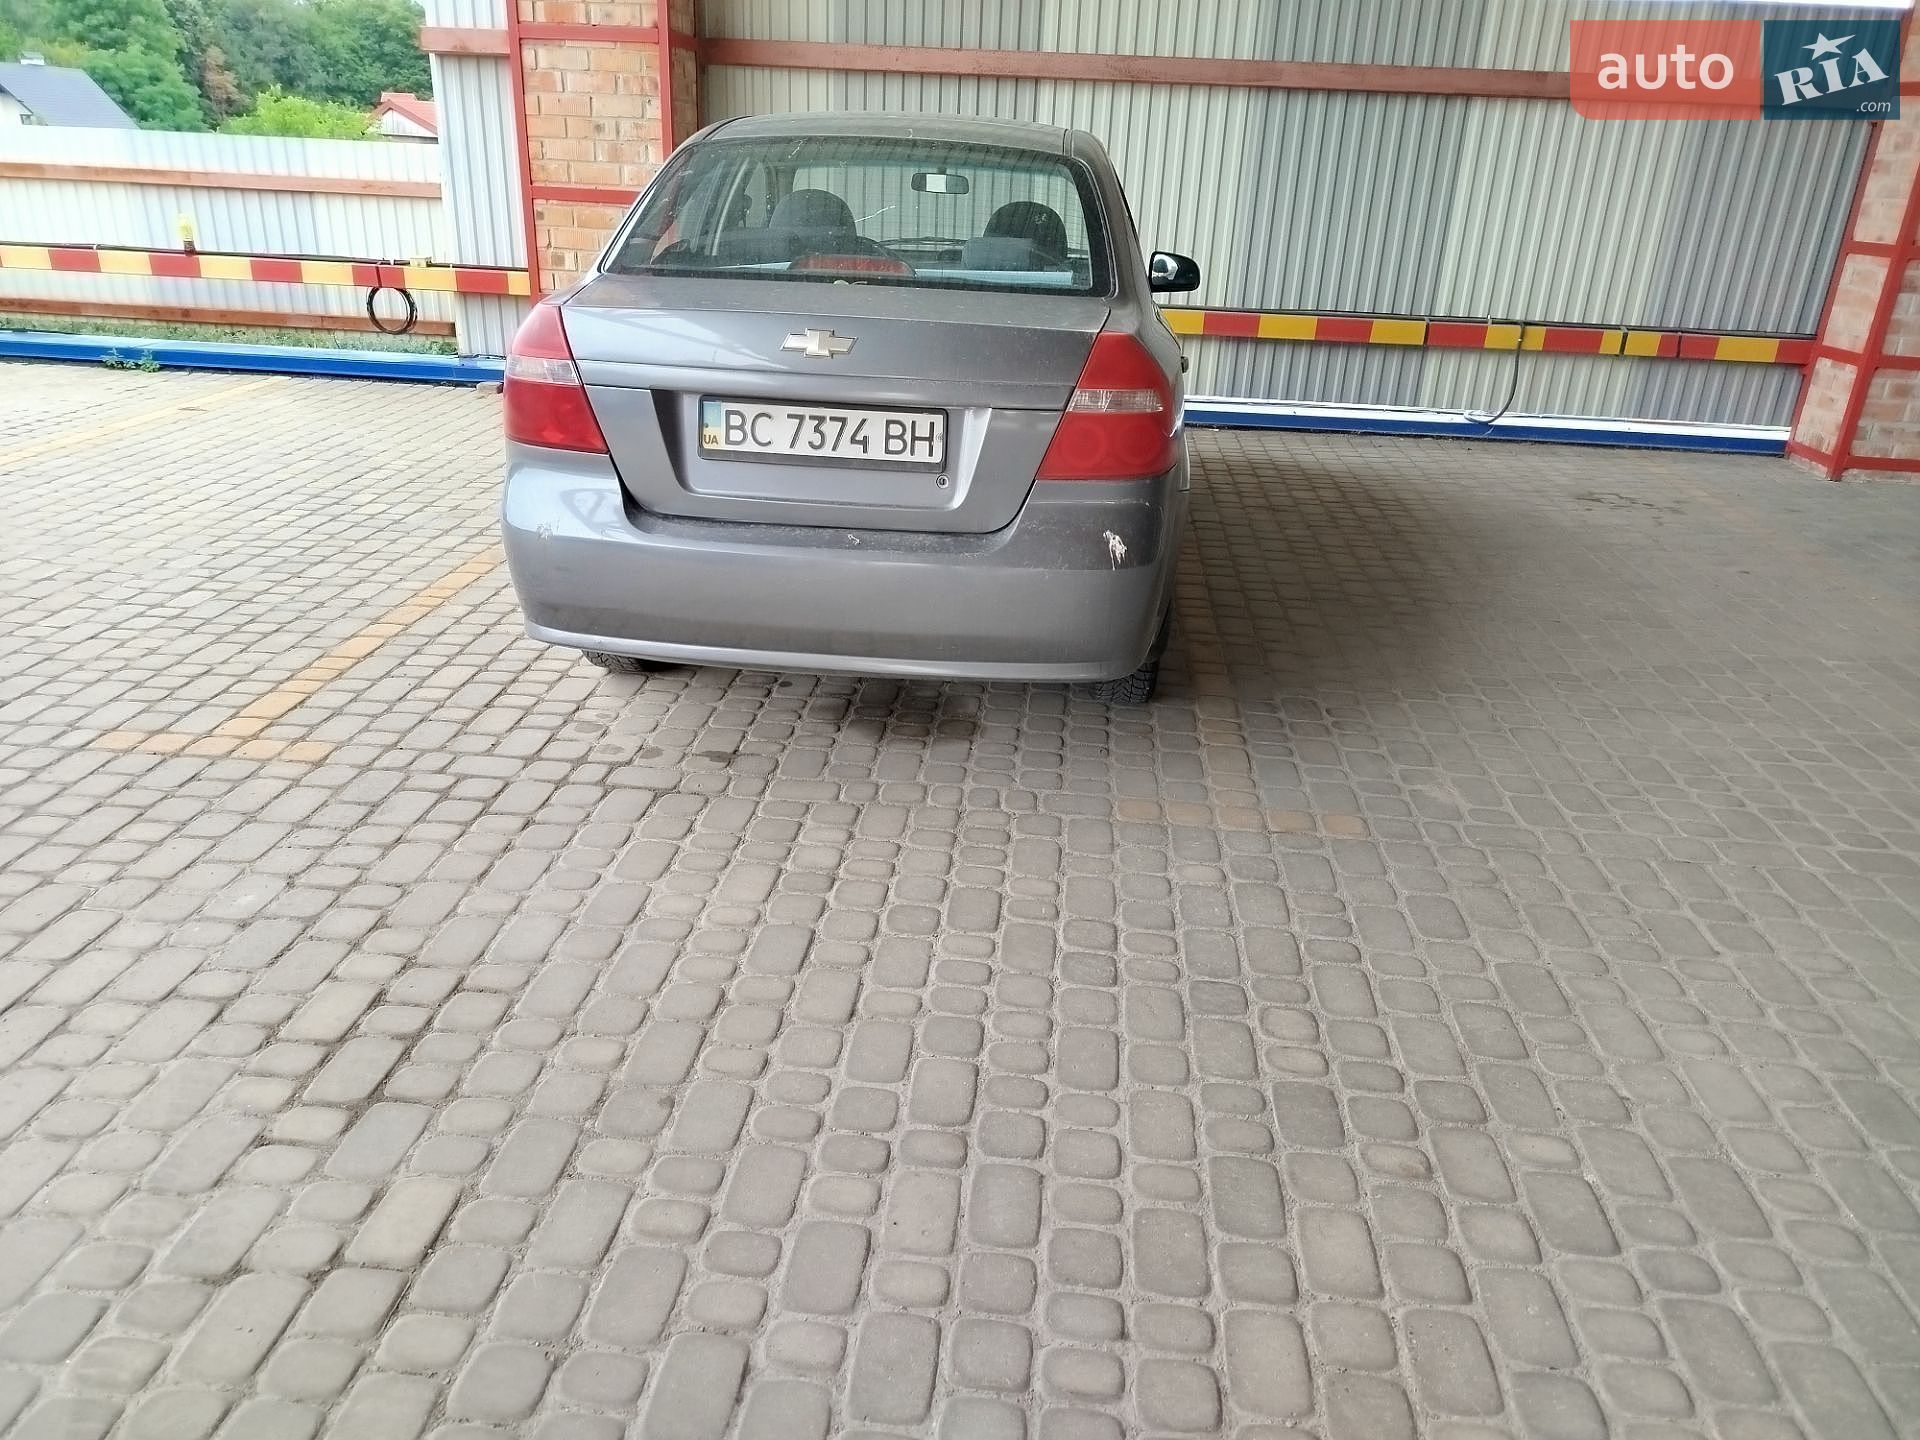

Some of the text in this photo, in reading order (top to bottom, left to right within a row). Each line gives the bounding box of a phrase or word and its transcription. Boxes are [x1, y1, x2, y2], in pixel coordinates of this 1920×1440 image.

[703, 434, 719, 446] UA
[724, 409, 935, 458] BC 7374 BH
